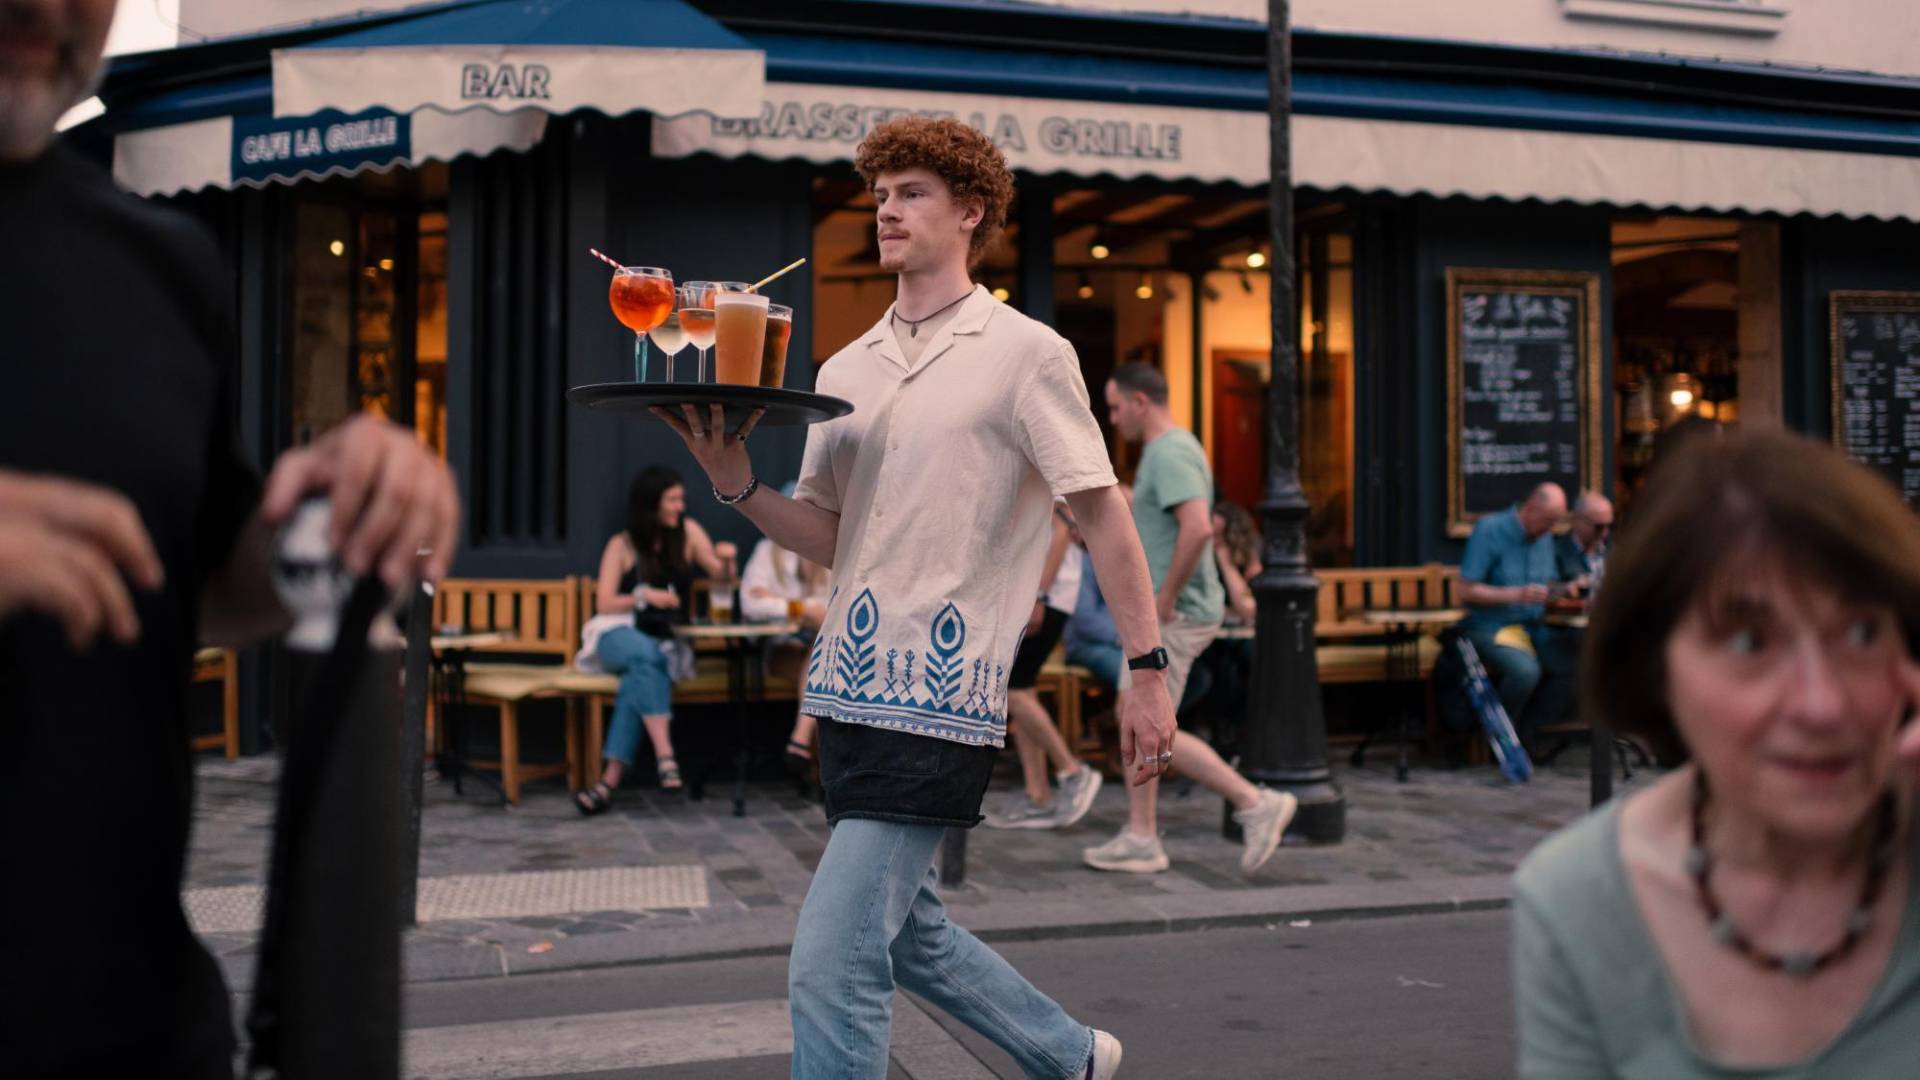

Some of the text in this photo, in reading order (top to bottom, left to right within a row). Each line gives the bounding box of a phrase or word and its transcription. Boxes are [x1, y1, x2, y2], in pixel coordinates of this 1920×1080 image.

[461, 64, 551, 99] BAR
[293, 127, 321, 157] LA
[325, 116, 398, 152] GRILLE
[1038, 115, 1182, 161] GRILLE
